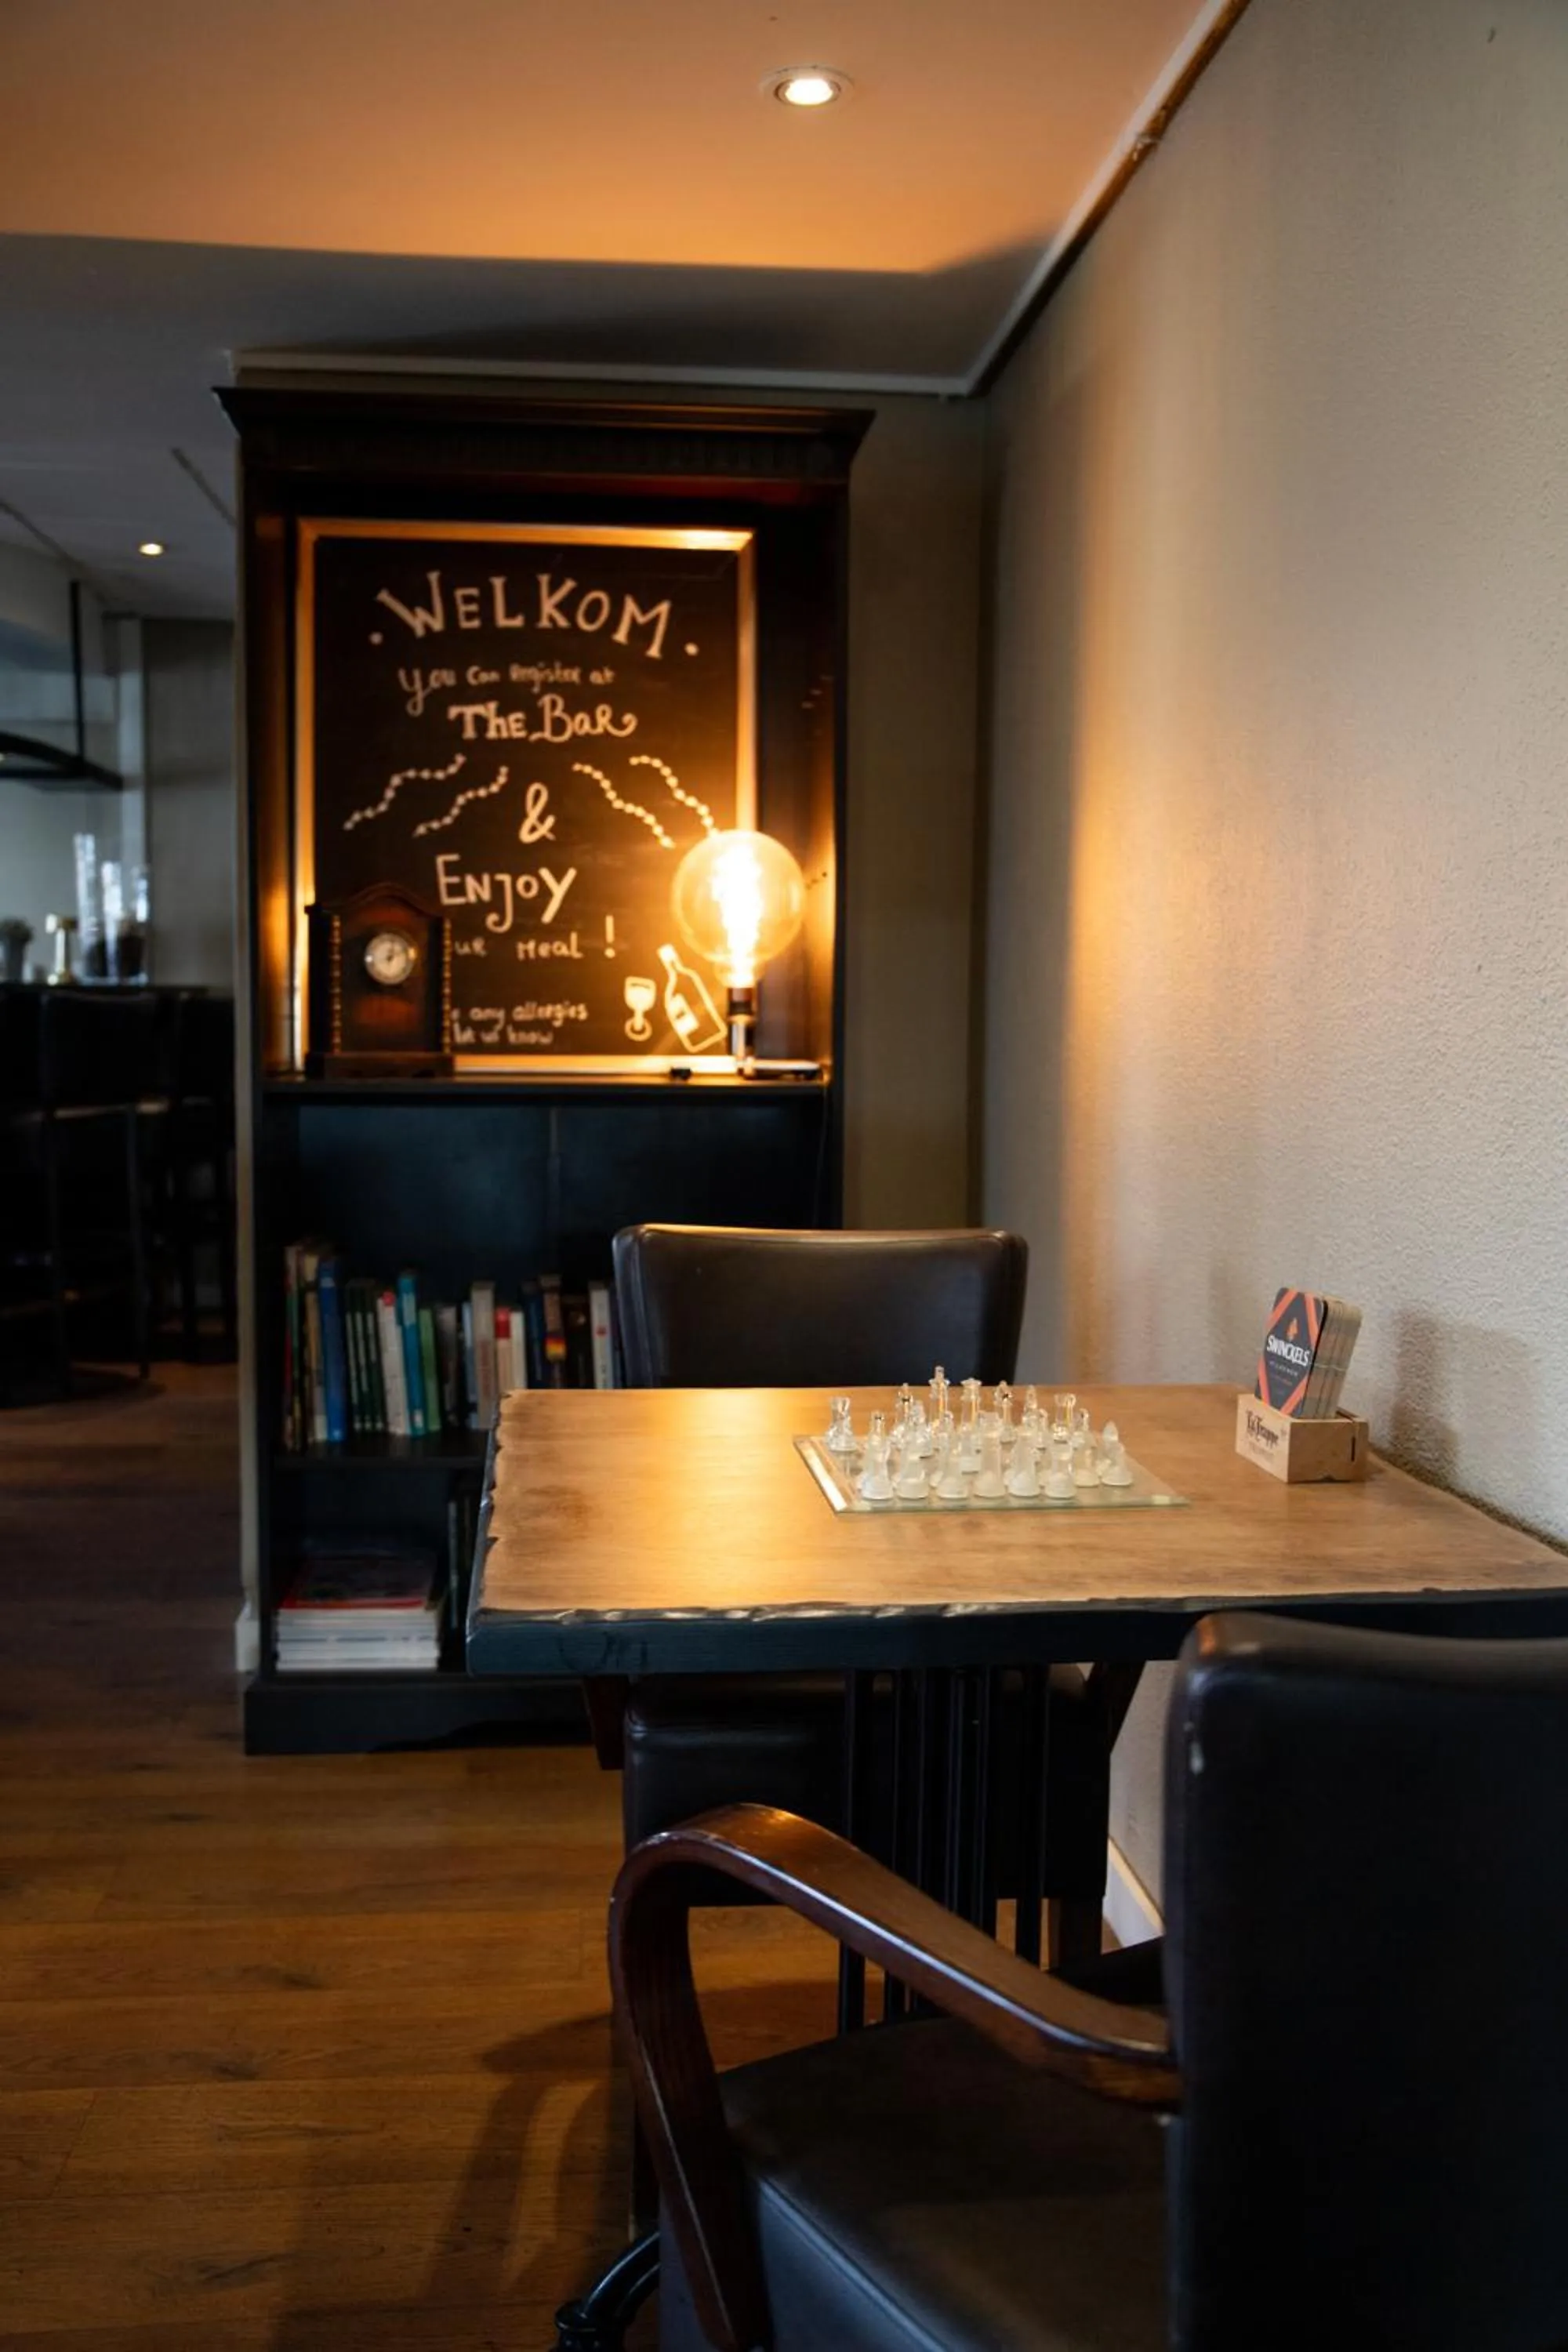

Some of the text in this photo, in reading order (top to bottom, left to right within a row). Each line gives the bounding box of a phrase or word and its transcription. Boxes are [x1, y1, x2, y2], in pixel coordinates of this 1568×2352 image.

[376, 571, 672, 659] WELKOM
[519, 782, 556, 844] &
[470, 1007, 504, 1032] any
[506, 1024, 554, 1044] know
